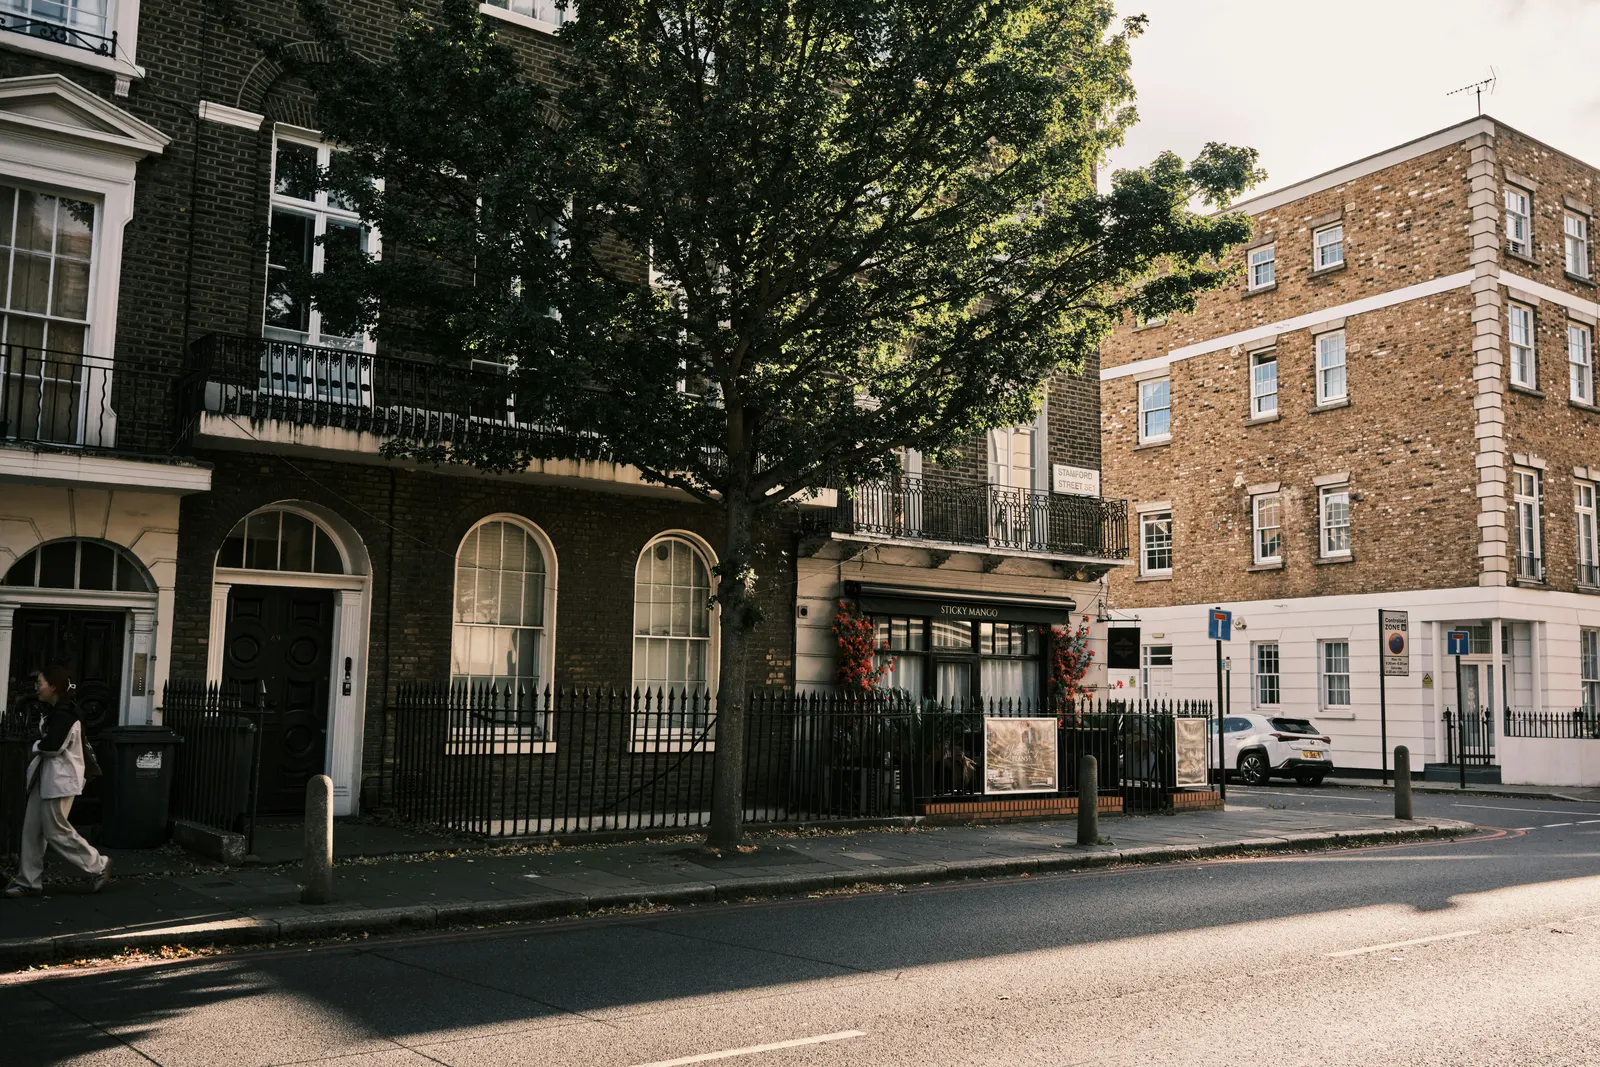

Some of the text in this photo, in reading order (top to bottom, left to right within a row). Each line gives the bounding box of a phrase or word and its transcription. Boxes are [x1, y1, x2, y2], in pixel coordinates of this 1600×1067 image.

[1058, 468, 1092, 480] STAMFORD
[1058, 480, 1096, 492] STREET SE1
[941, 605, 998, 617] STICKY MANGO
